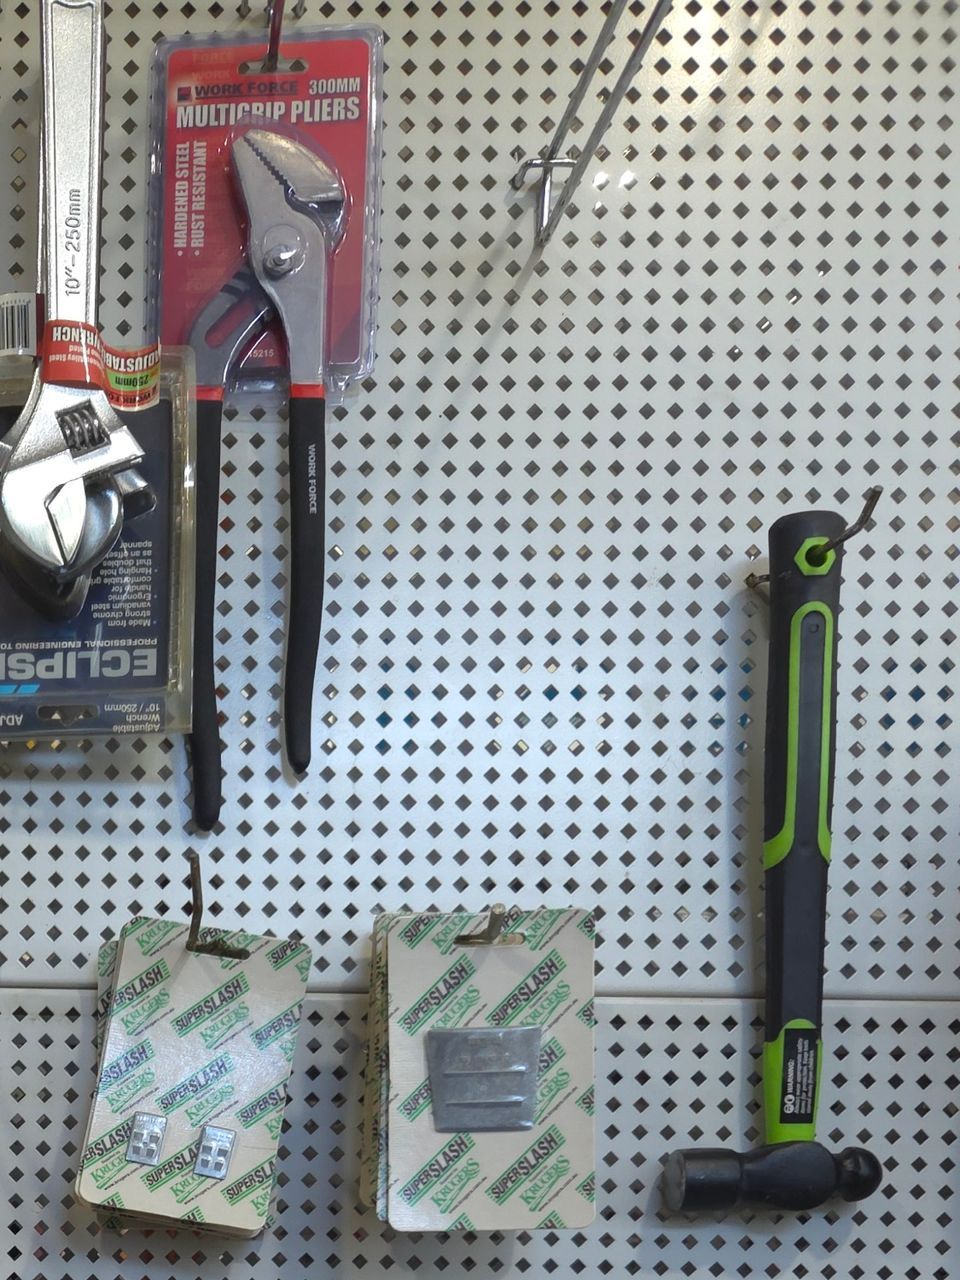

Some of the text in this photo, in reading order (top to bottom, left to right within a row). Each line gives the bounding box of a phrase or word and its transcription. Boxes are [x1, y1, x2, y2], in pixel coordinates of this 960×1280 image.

[195, 81, 298, 97] WORK FORCE
[308, 77, 360, 96] 300MM
[176, 97, 360, 129] MULTIGRIP PLIERS
[174, 141, 189, 248] HARDENED STEEL
[191, 141, 207, 248] RUST RESISTANT
[308, 443, 317, 515] WORK FORCE
[103, 559, 135, 567] doubles
[99, 567, 153, 576] Hanging hole
[103, 576, 152, 585] comfortable
[108, 592, 152, 602] Ergonomic
[90, 602, 151, 611] vanadium steel
[125, 610, 151, 618] strong
[107, 619, 151, 628] Made from
[15, 640, 82, 649] ENGINEERING
[84, 637, 158, 646] PROFESSIONAL
[126, 714, 161, 722] Wrench
[112, 723, 161, 733] Adjustable
[404, 964, 468, 1032] SUPERSLASH
[490, 957, 560, 1026] SUPERSLASH
[175, 978, 244, 1032] SUPERSLASH
[159, 1058, 229, 1111] SUPERSLASH
[402, 1136, 468, 1201] SUPERSLASH
[490, 1133, 559, 1200] SUPERSLASH
